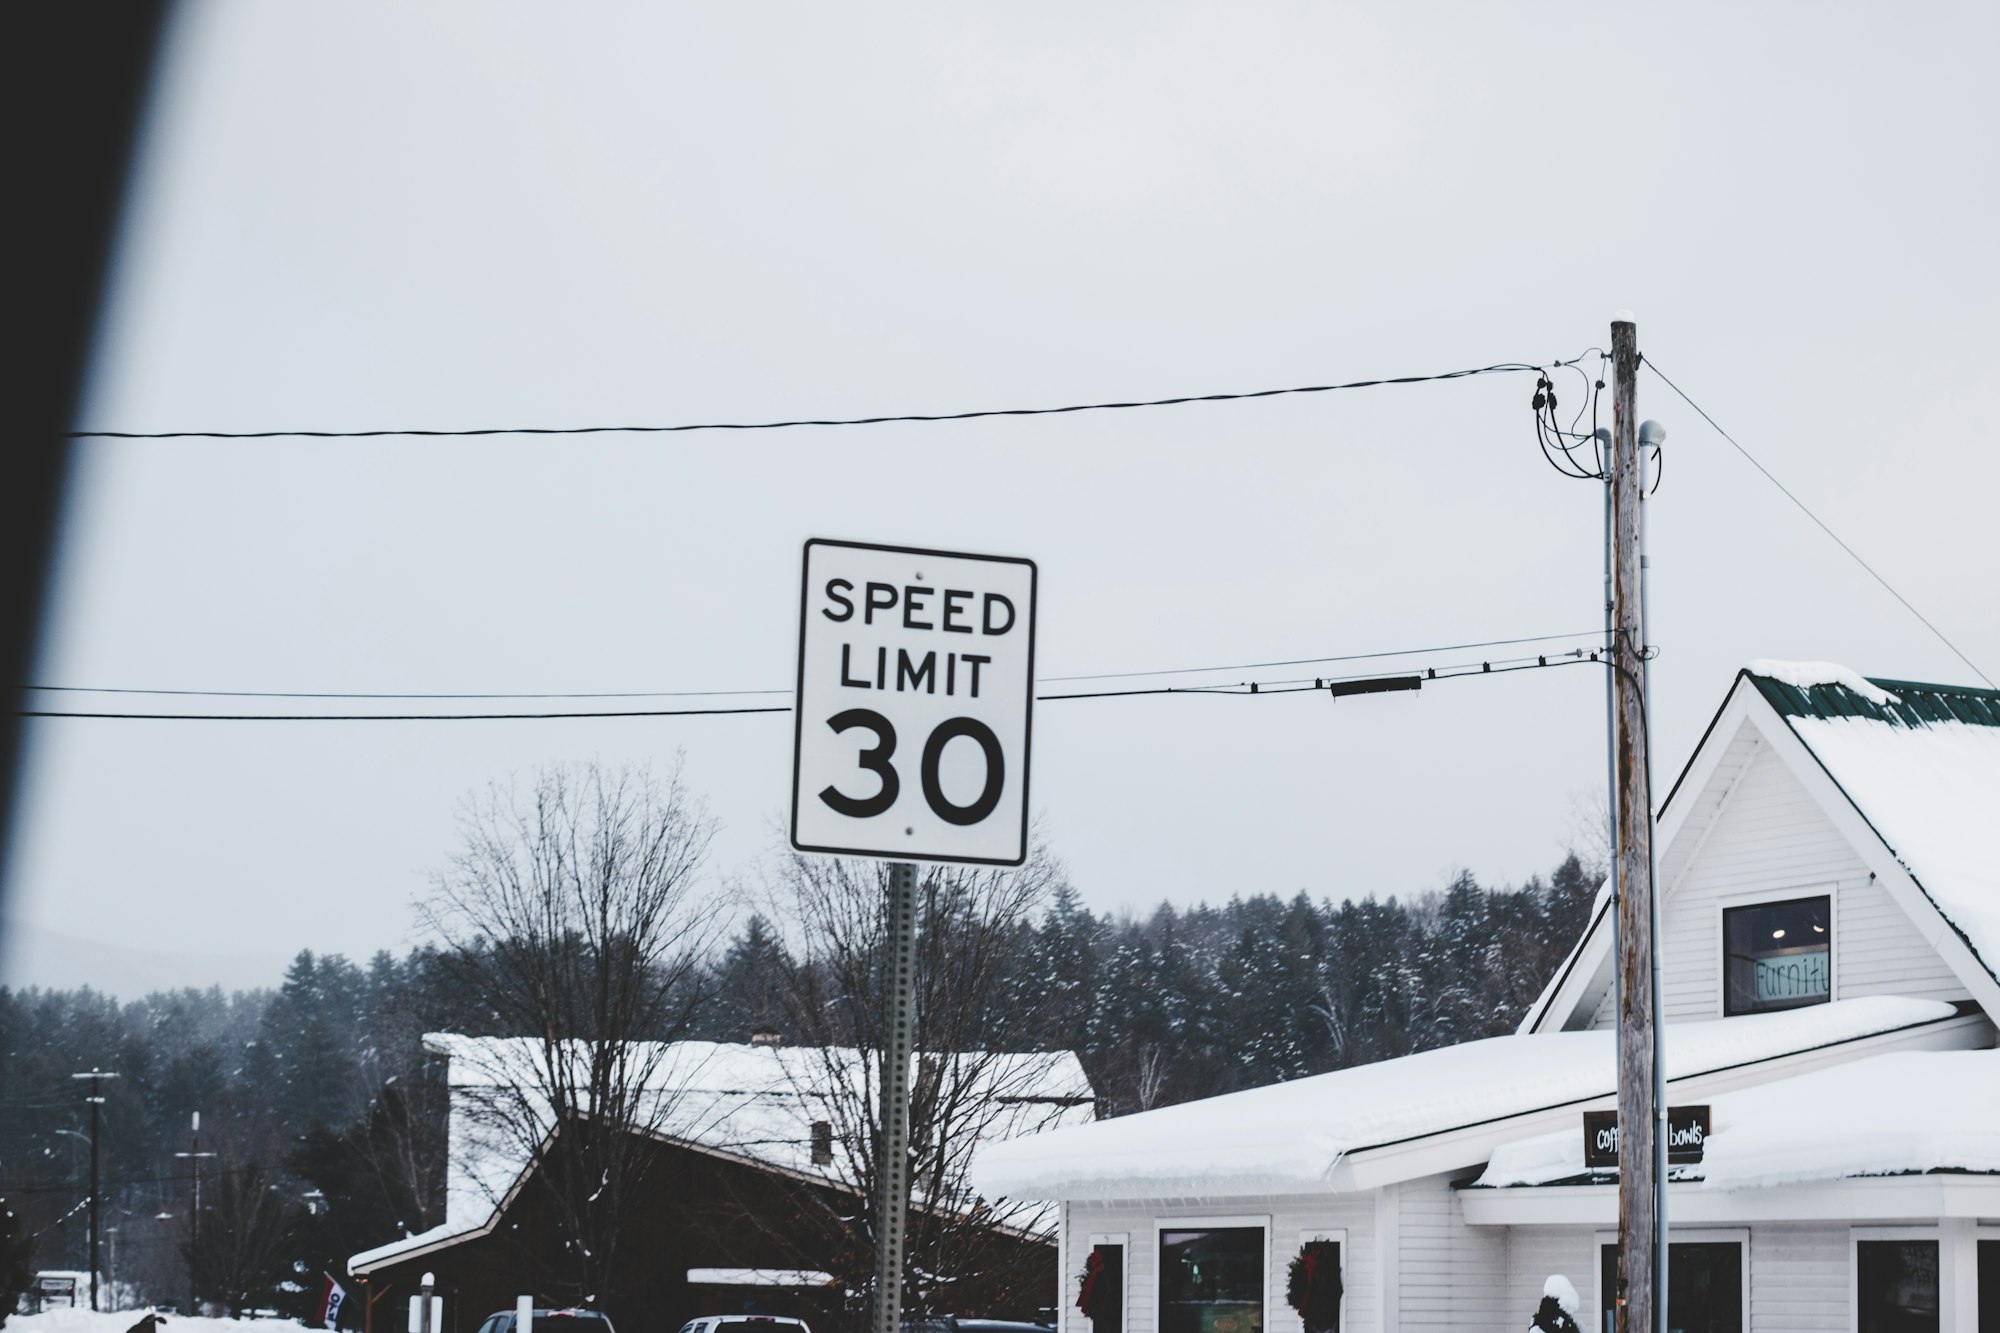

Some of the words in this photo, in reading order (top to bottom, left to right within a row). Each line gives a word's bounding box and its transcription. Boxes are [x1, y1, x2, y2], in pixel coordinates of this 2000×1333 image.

[822, 578, 1015, 636] SPEED
[841, 643, 991, 698] LIMIT
[818, 708, 1005, 826] 30
[1755, 957, 1829, 1000] Furnitu
[1668, 1119, 1703, 1146] bowls
